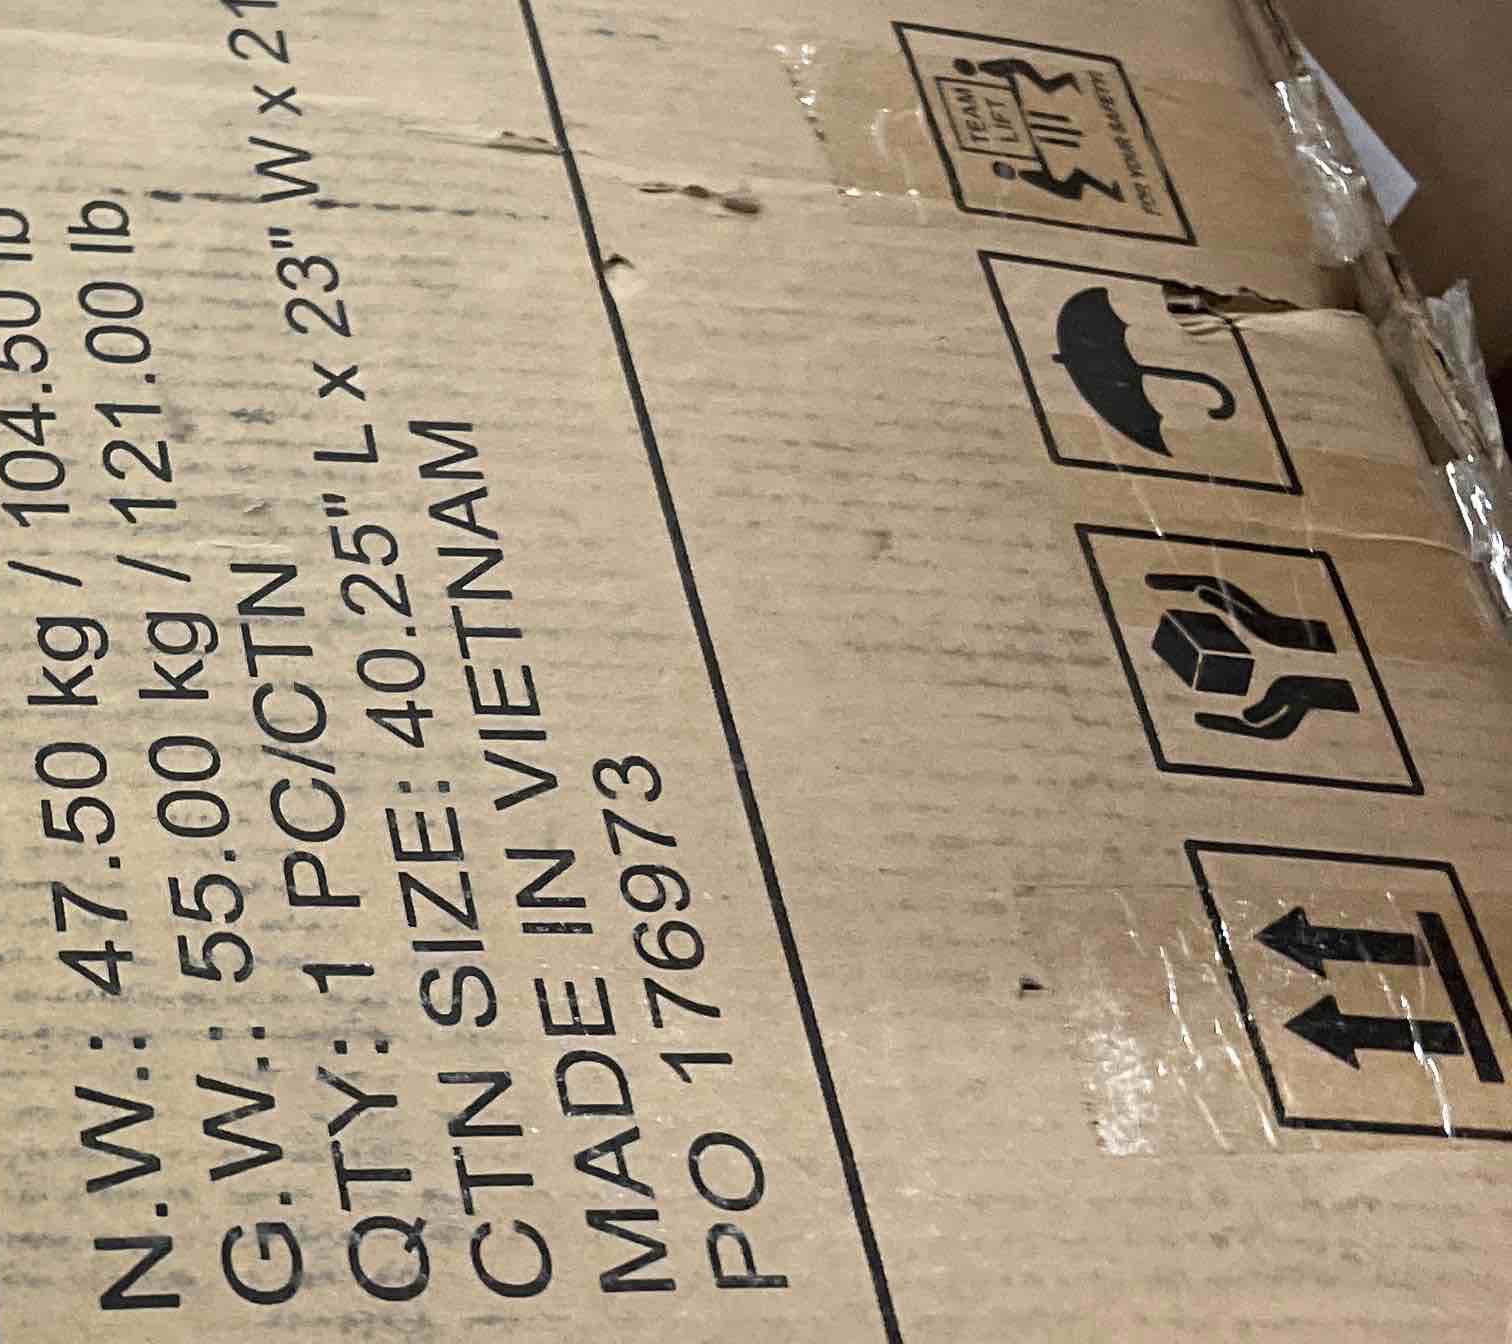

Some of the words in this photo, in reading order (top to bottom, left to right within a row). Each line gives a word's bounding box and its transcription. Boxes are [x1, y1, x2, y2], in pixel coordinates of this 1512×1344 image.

[254, 86, 302, 116] x
[954, 88, 991, 144] TEAM
[984, 97, 1021, 143] LIFT
[250, 137, 320, 209] W
[1112, 136, 1146, 179] YOUR
[68, 201, 134, 253] lb
[268, 227, 351, 337] 23"
[78, 282, 176, 523] 121.00
[312, 362, 365, 401] x
[314, 424, 378, 463] L
[8, 561, 82, 587] /
[116, 555, 191, 582] /
[322, 494, 433, 748] 40.25"
[408, 421, 558, 811] VIETNAM
[28, 617, 108, 705] kg
[139, 612, 218, 699] kg
[230, 563, 360, 907] PC/CTN
[35, 742, 133, 996] 47.50
[148, 736, 253, 982] 55.00
[385, 781, 497, 1027] SIZE:
[505, 849, 593, 934] IN
[593, 756, 732, 1083] 176973
[302, 964, 374, 993] 1
[75, 1036, 180, 1310] N.W.:
[196, 1027, 303, 1305] G.W.:
[318, 1040, 430, 1301] QTY:
[438, 1072, 552, 1298] CTN
[534, 978, 676, 1293] MADE
[688, 1132, 788, 1288] PO
